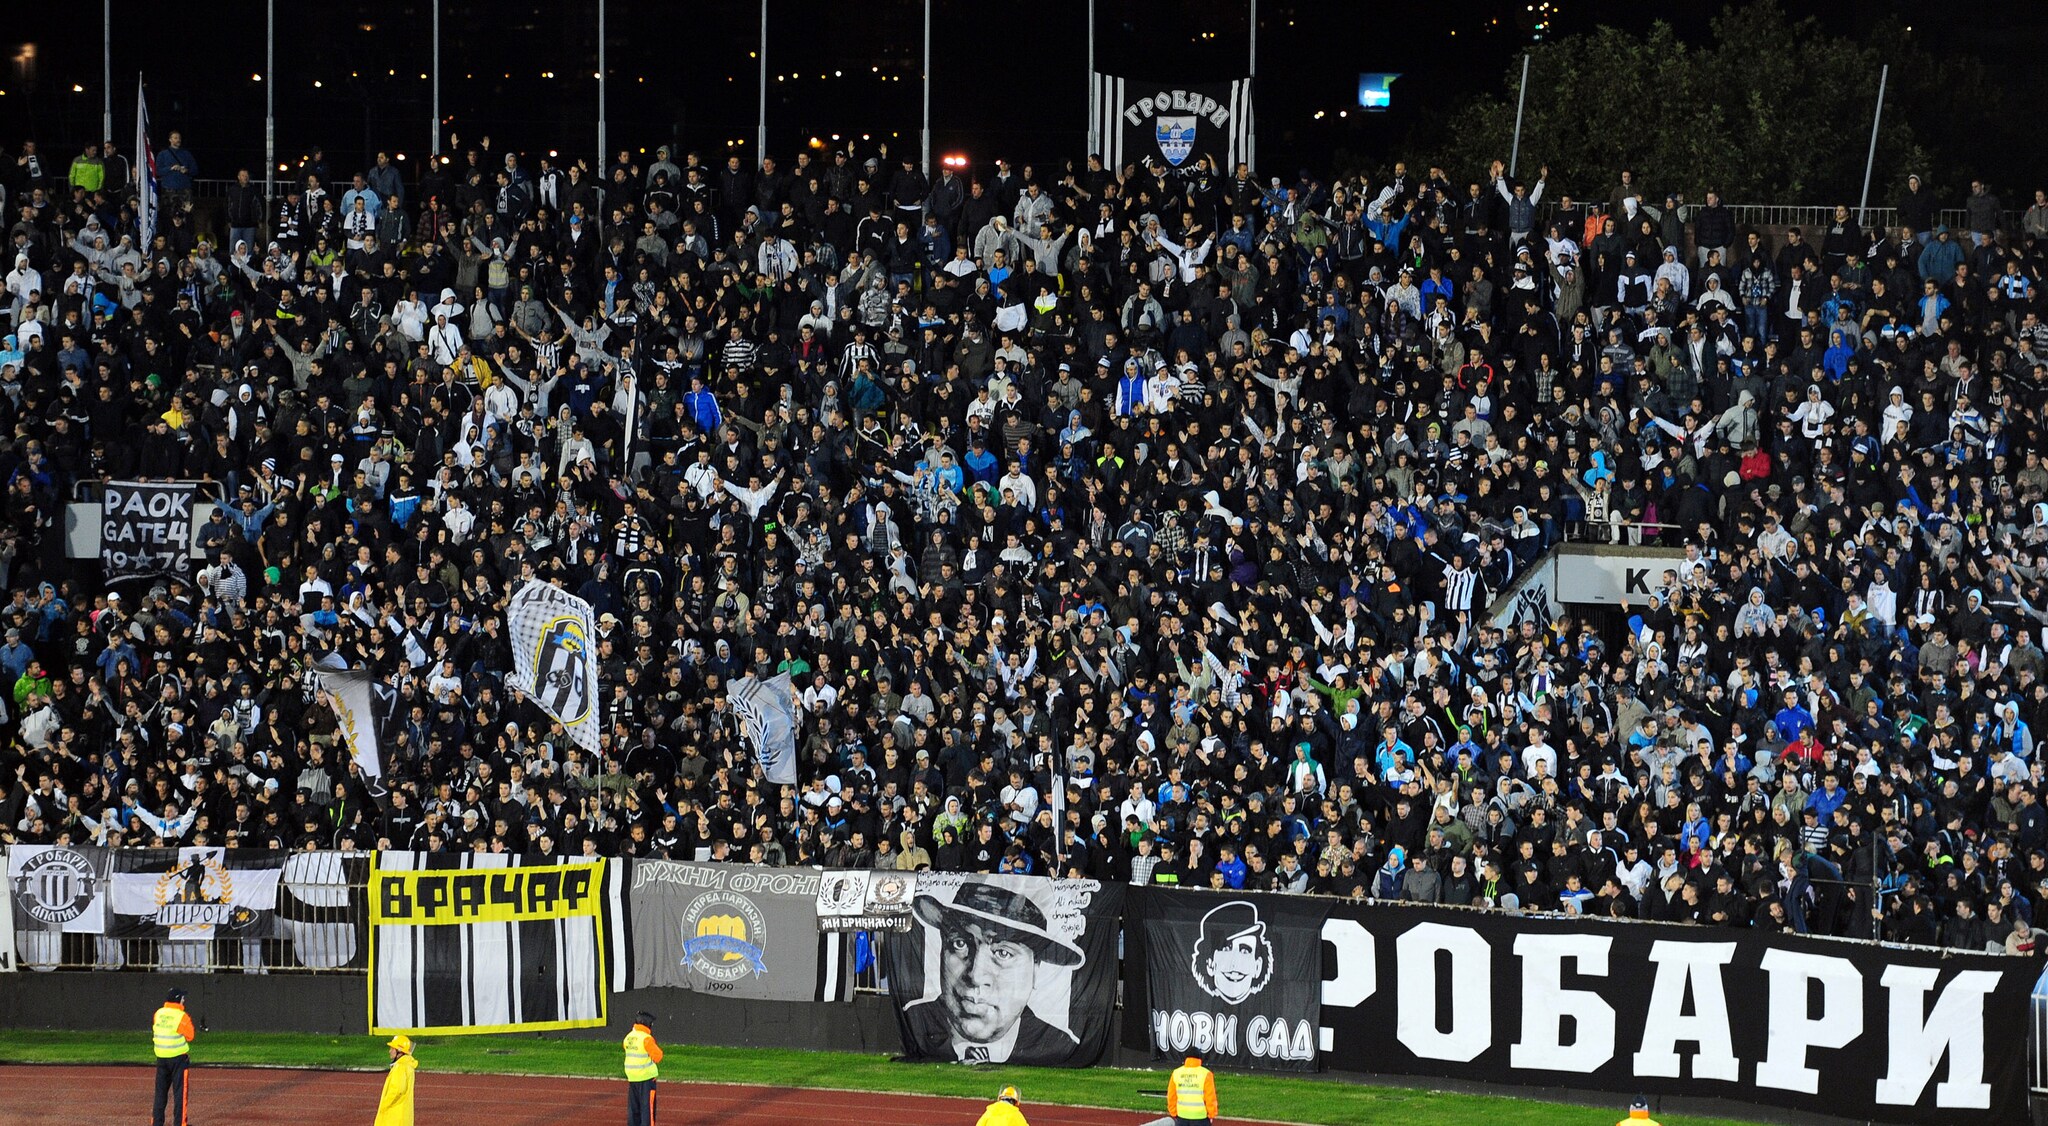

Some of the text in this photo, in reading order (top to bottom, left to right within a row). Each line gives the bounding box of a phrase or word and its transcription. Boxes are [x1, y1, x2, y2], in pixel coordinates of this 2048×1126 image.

[1124, 90, 1230, 129] ГРОБАРИ
[105, 489, 190, 519] PAOK
[102, 548, 190, 572] 19 76
[1626, 568, 1651, 594] K
[28, 850, 88, 870] ГРОБАРИ
[381, 868, 592, 918] ВРАЧАР
[30, 905, 80, 922] АПАТИН
[686, 892, 762, 935] НАПРЕД ПАРТИЗАН
[696, 958, 748, 978] ГРОБАРИ
[708, 981, 734, 991] 1999
[1152, 1009, 1315, 1062] НОВИ САД
